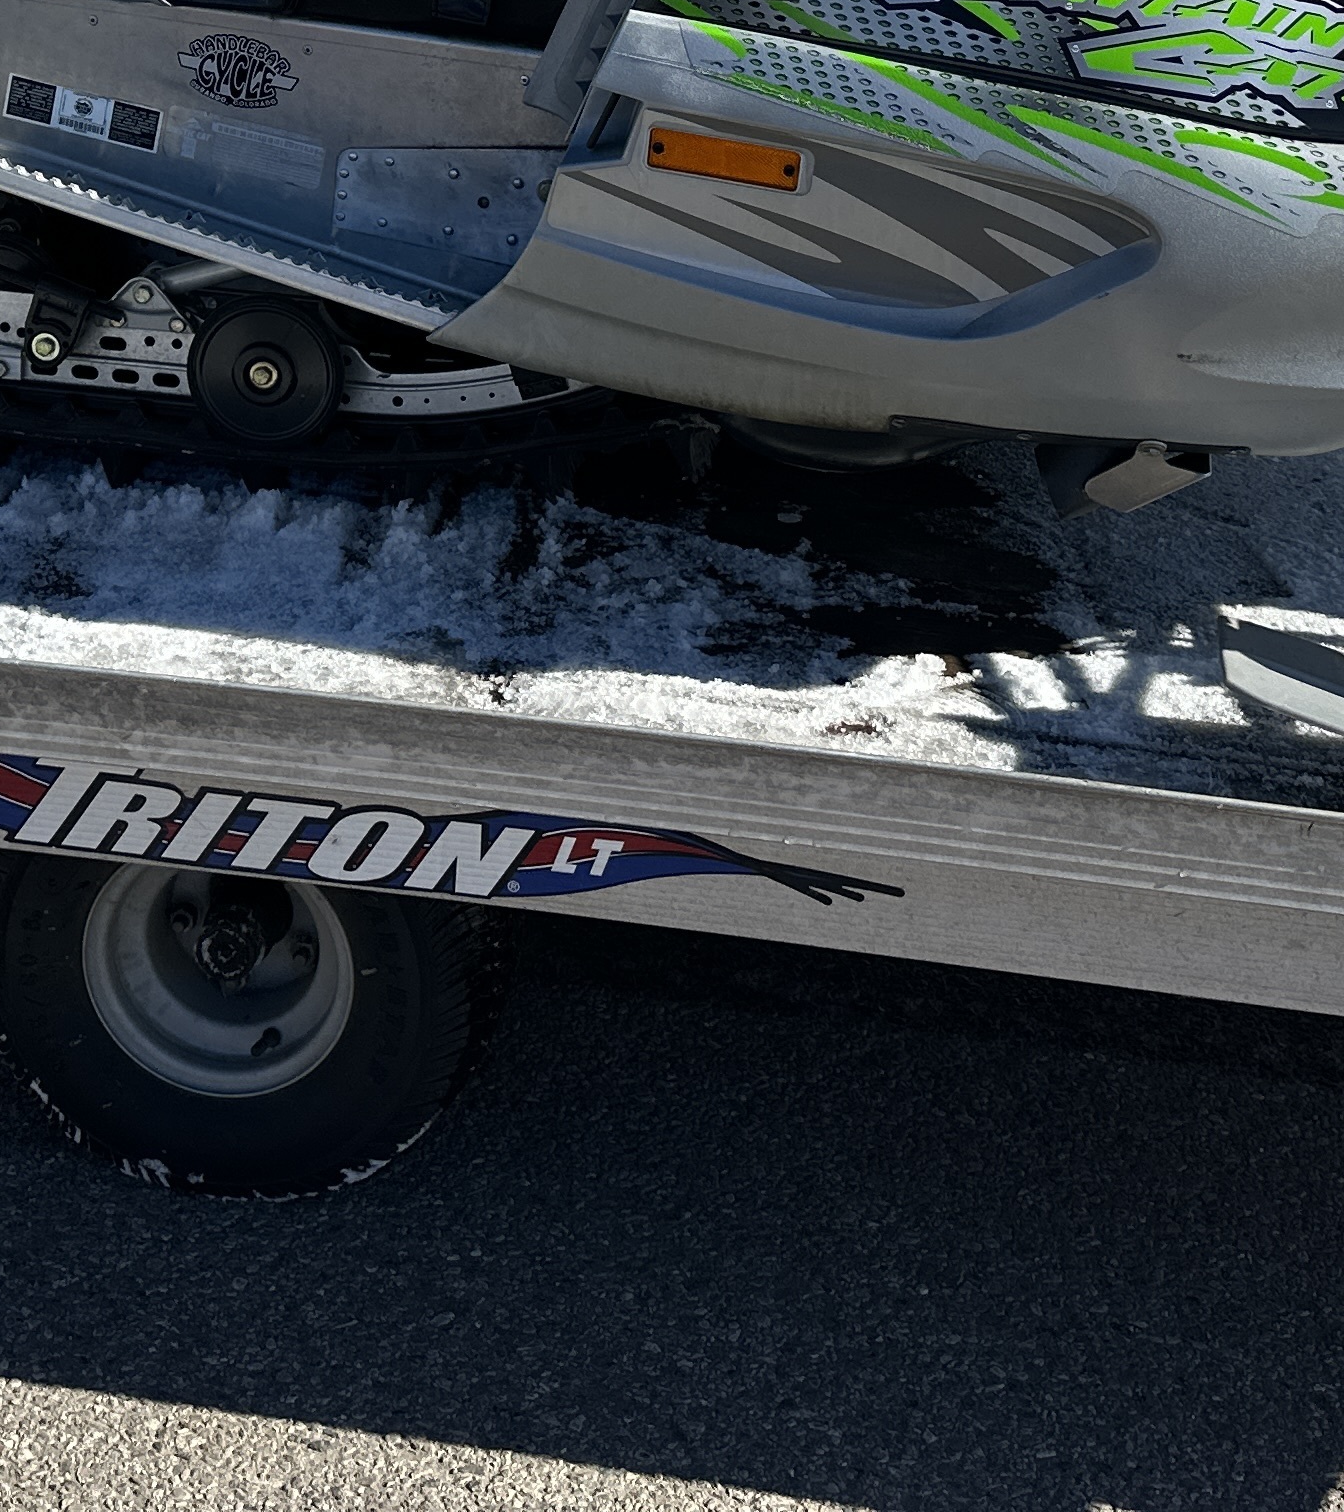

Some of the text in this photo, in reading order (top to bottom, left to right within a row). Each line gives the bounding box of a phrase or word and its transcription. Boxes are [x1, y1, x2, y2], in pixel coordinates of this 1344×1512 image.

[190, 35, 290, 76] HANDLEBAR
[197, 50, 277, 101] CYCLE
[233, 98, 277, 108] COLORADO
[13, 757, 626, 897] TRITON LT
